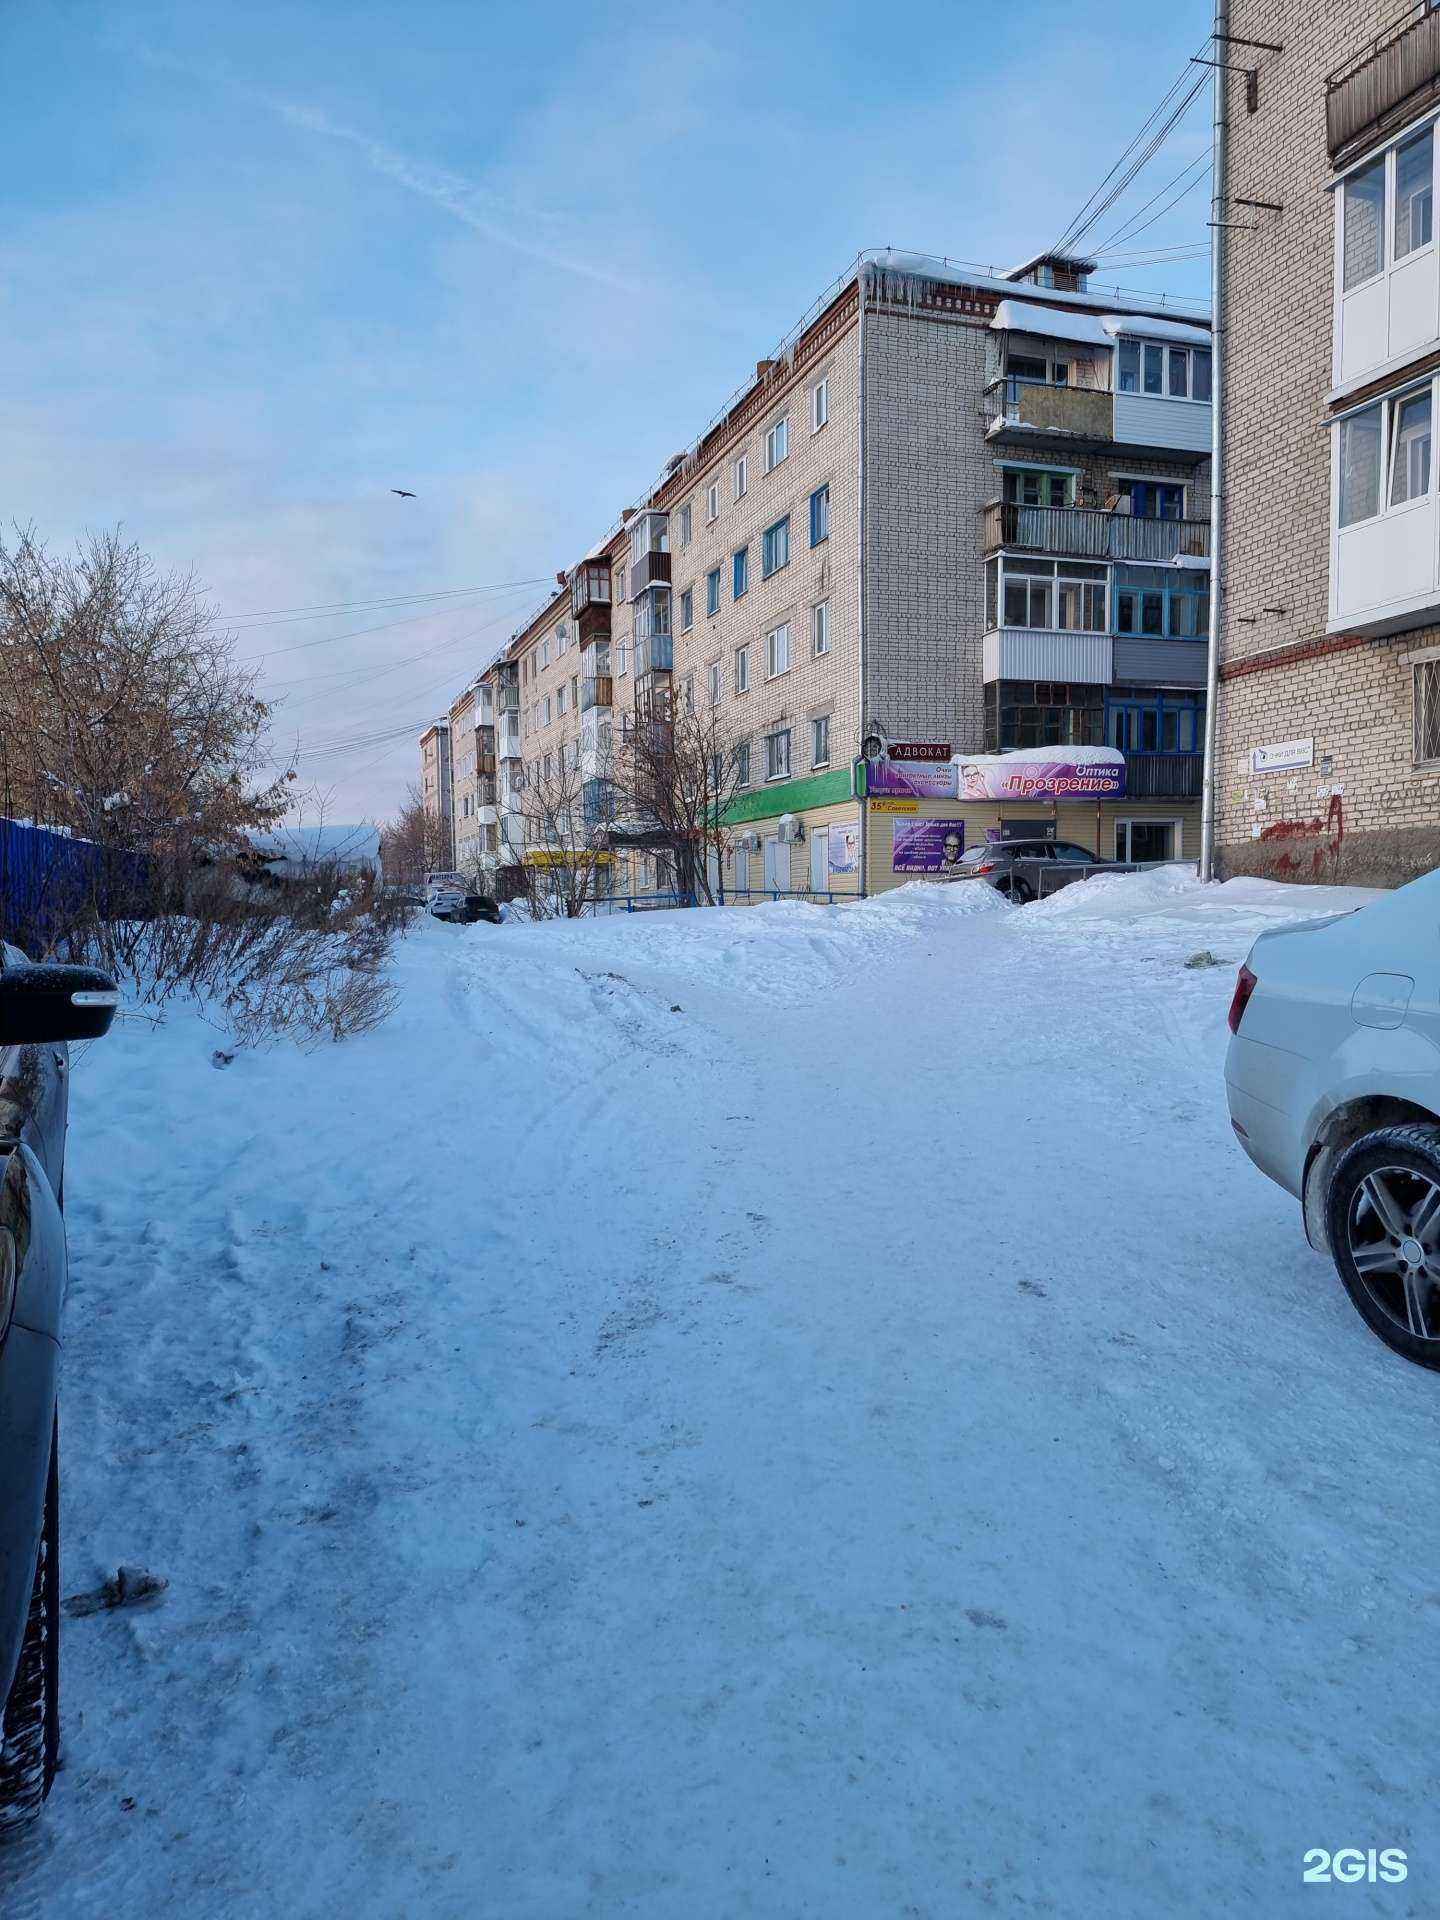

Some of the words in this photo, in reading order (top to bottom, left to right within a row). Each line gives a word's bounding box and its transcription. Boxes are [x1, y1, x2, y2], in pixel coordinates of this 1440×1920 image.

[895, 747, 950, 757] АДВОКАТ
[1076, 764, 1119, 776] Оптика
[1001, 775, 1119, 796] «Прозрение»
